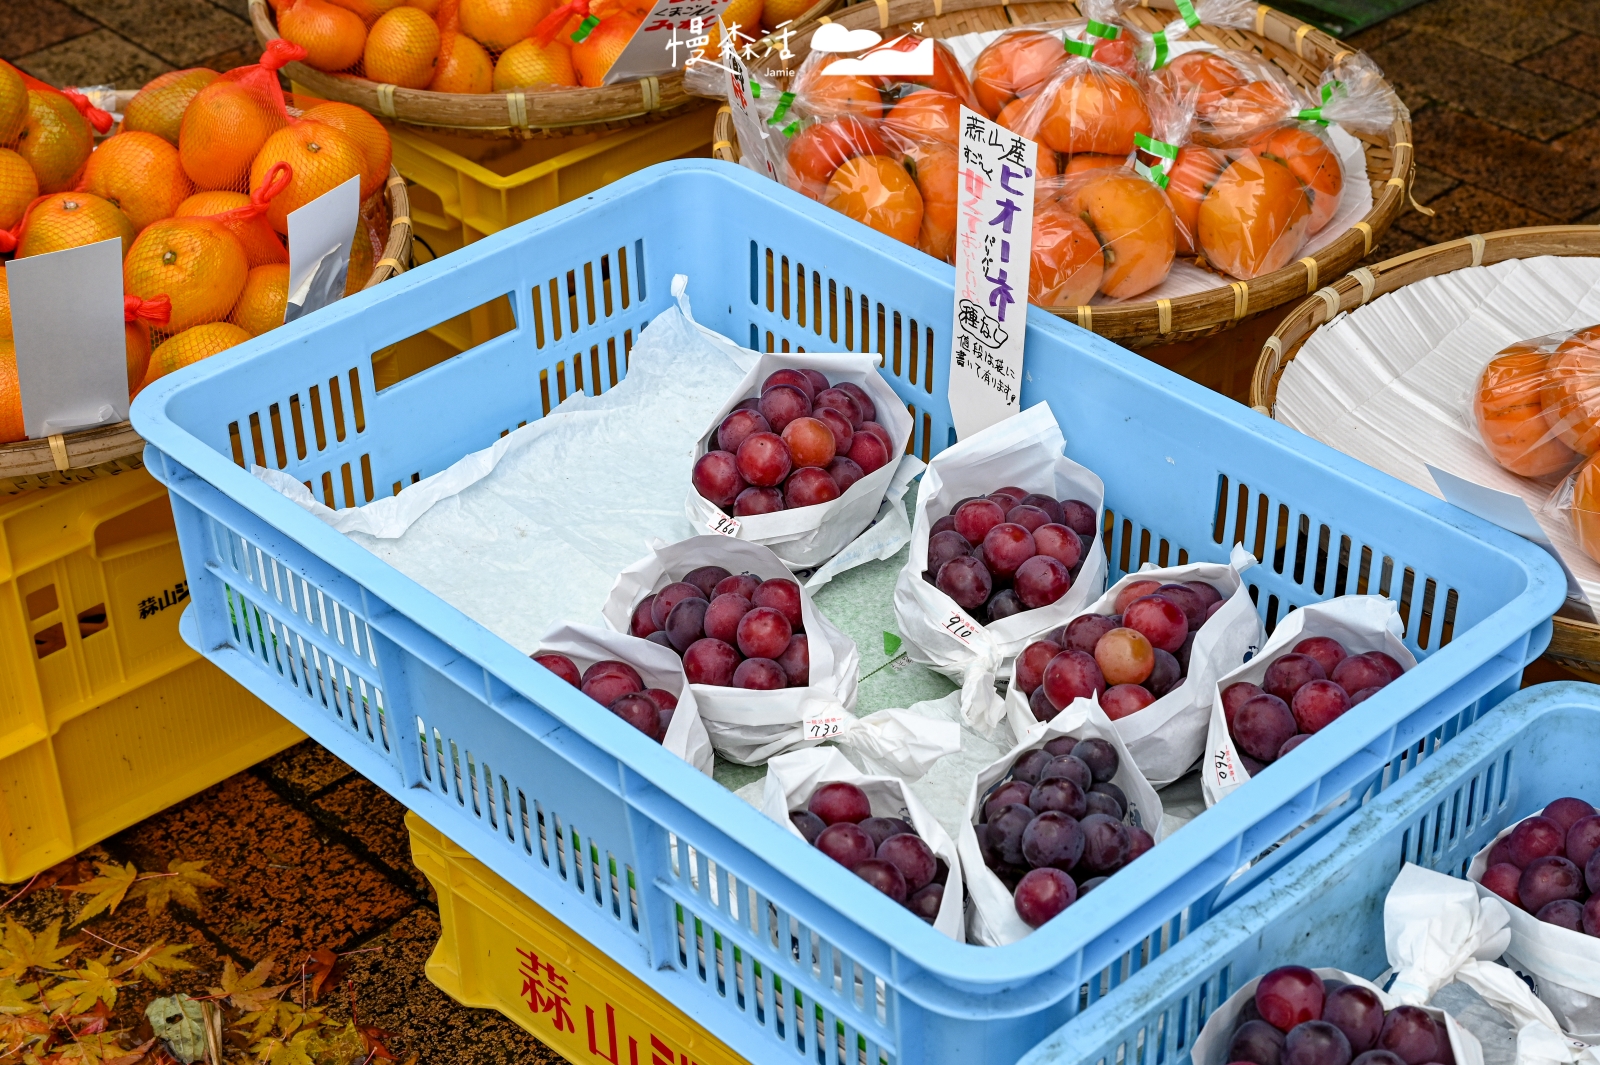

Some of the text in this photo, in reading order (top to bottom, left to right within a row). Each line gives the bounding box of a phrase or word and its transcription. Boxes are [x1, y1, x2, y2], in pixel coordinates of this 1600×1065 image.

[965, 116, 1026, 168] 蒜山産
[960, 305, 1002, 345] 種なし
[714, 518, 735, 535] 960
[949, 616, 972, 637] 910
[810, 723, 838, 737] 730
[1214, 750, 1228, 779] 760
